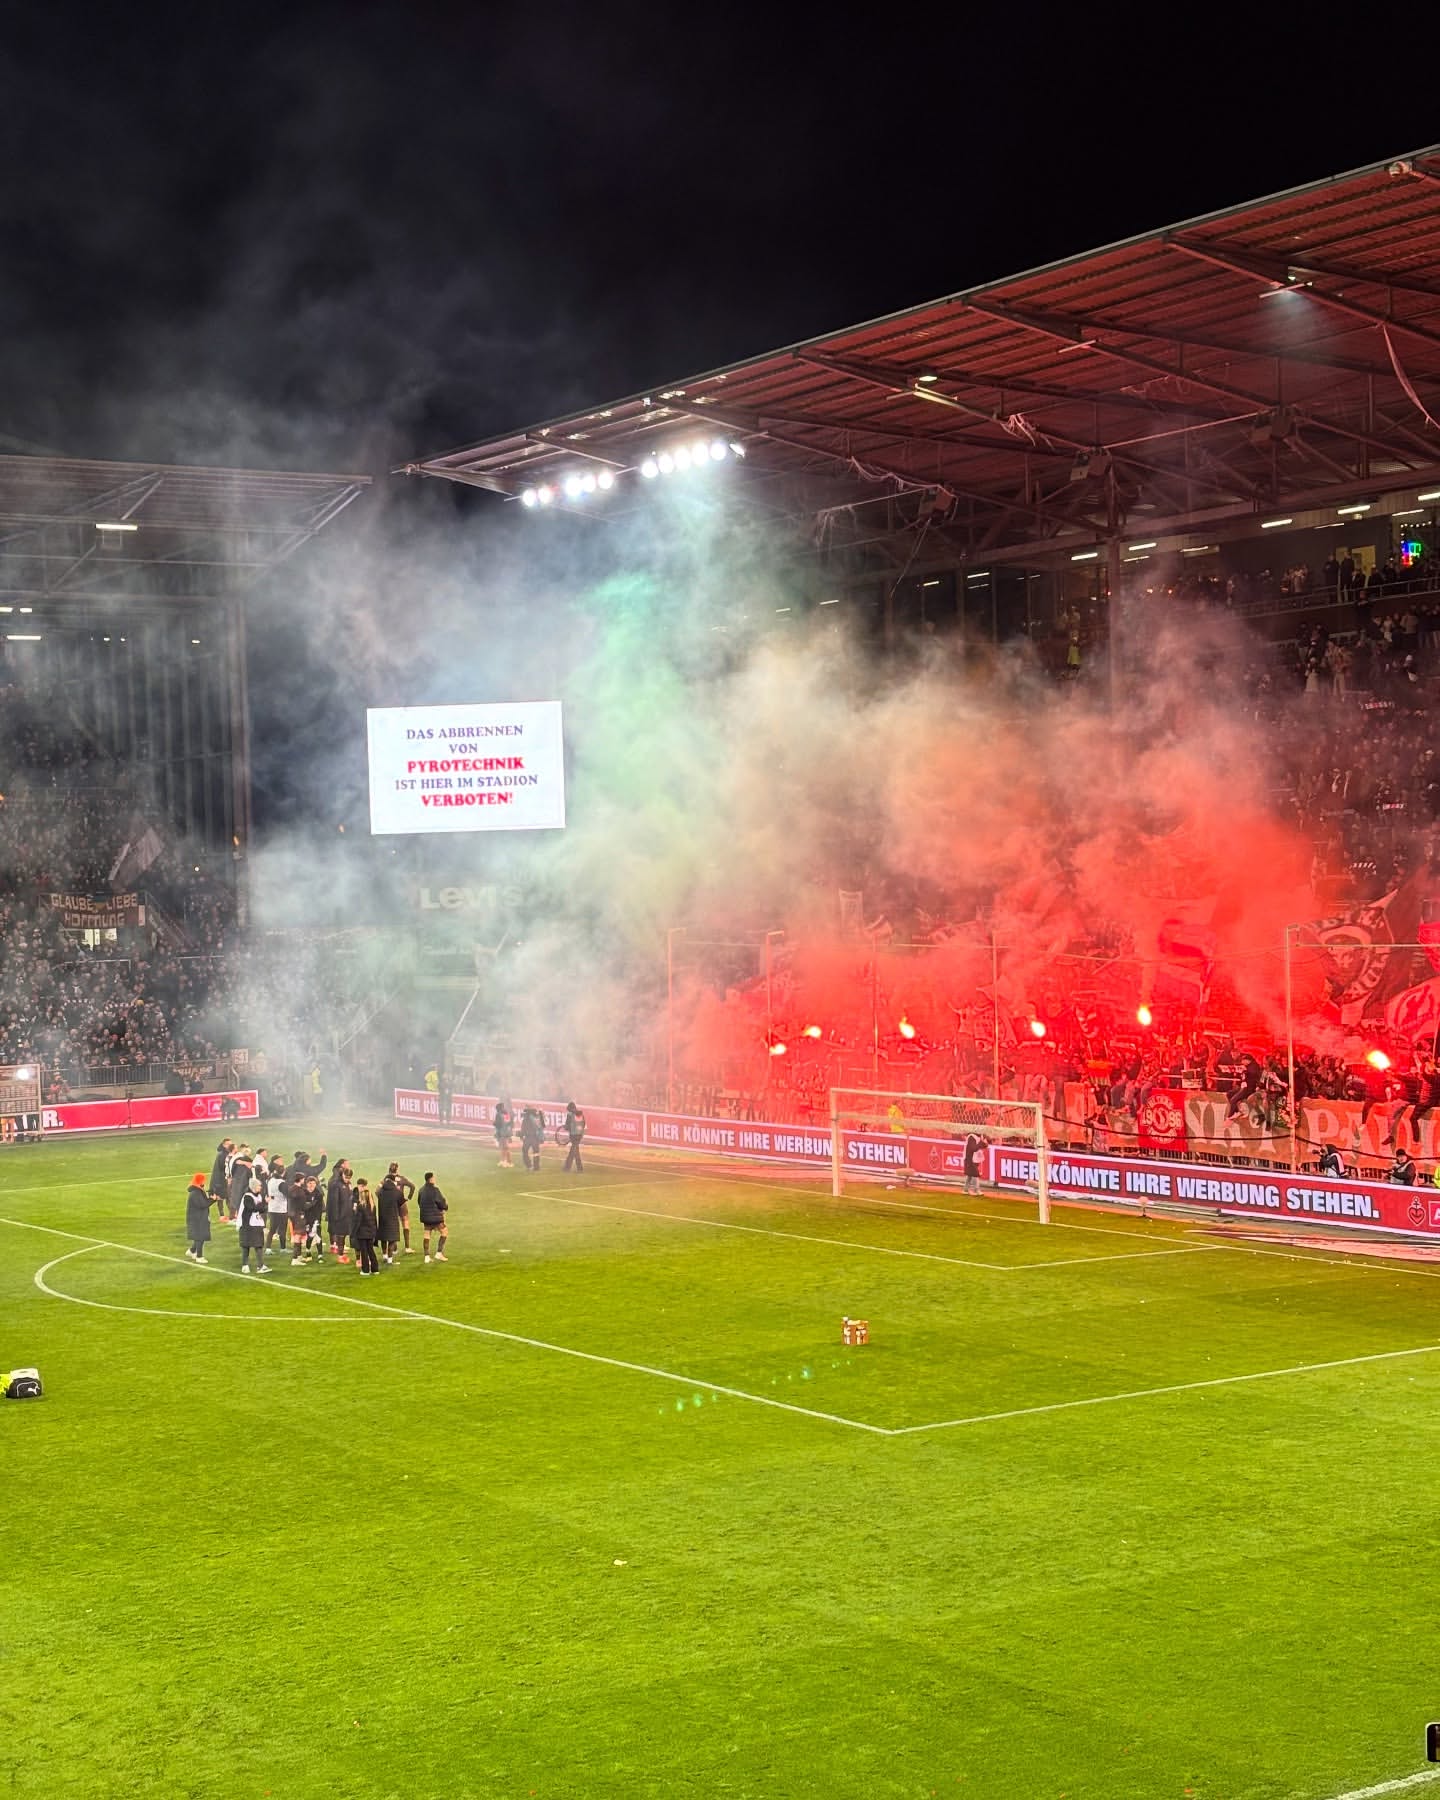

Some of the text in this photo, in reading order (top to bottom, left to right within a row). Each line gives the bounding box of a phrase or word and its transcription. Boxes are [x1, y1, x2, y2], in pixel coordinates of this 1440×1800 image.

[406, 725, 524, 740] DAS ABBRENNEN
[449, 743, 478, 754] VON
[407, 757, 525, 773] PYROTECHNIK
[395, 775, 538, 790] IST HIER IM STADION
[421, 792, 513, 807] VERBOTEN!
[50, 892, 138, 911] GLAUBE LIEBE
[399, 1097, 420, 1113] HIER
[464, 1103, 487, 1120] IHRE
[651, 1122, 679, 1141] HIER
[683, 1123, 735, 1147] KÖNNTE
[739, 1131, 771, 1151] IHRE
[774, 1135, 843, 1158] WERBUN
[1000, 1158, 1380, 1219] HIER KÖNNTE IHRE WERBUNG STEHEN.
